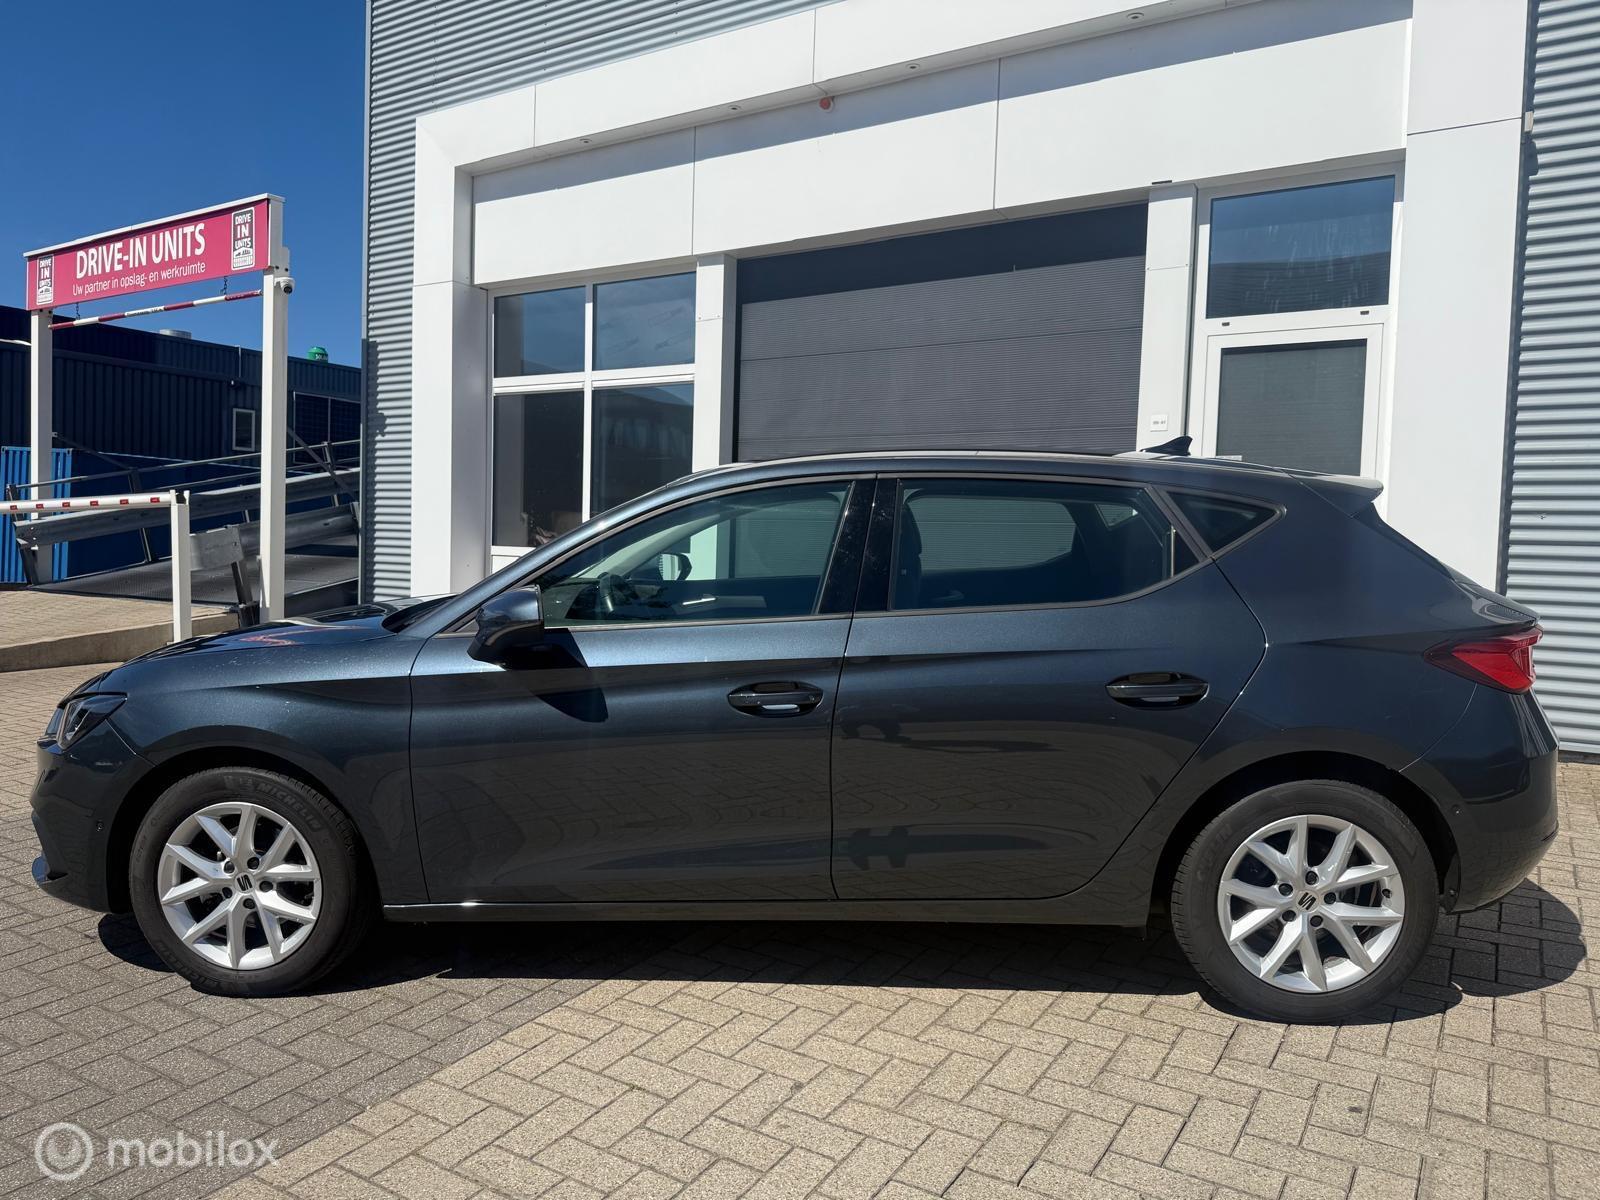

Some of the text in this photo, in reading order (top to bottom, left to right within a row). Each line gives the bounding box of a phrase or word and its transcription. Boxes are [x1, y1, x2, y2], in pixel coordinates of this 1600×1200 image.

[235, 213, 251, 225] DRIVE
[237, 223, 249, 239] IN
[235, 237, 251, 250] UNITS
[76, 223, 206, 279] DRIVE-IN UNITS
[41, 267, 50, 279] IN
[72, 261, 206, 296] Uw partner in opslag- en werkruimte
